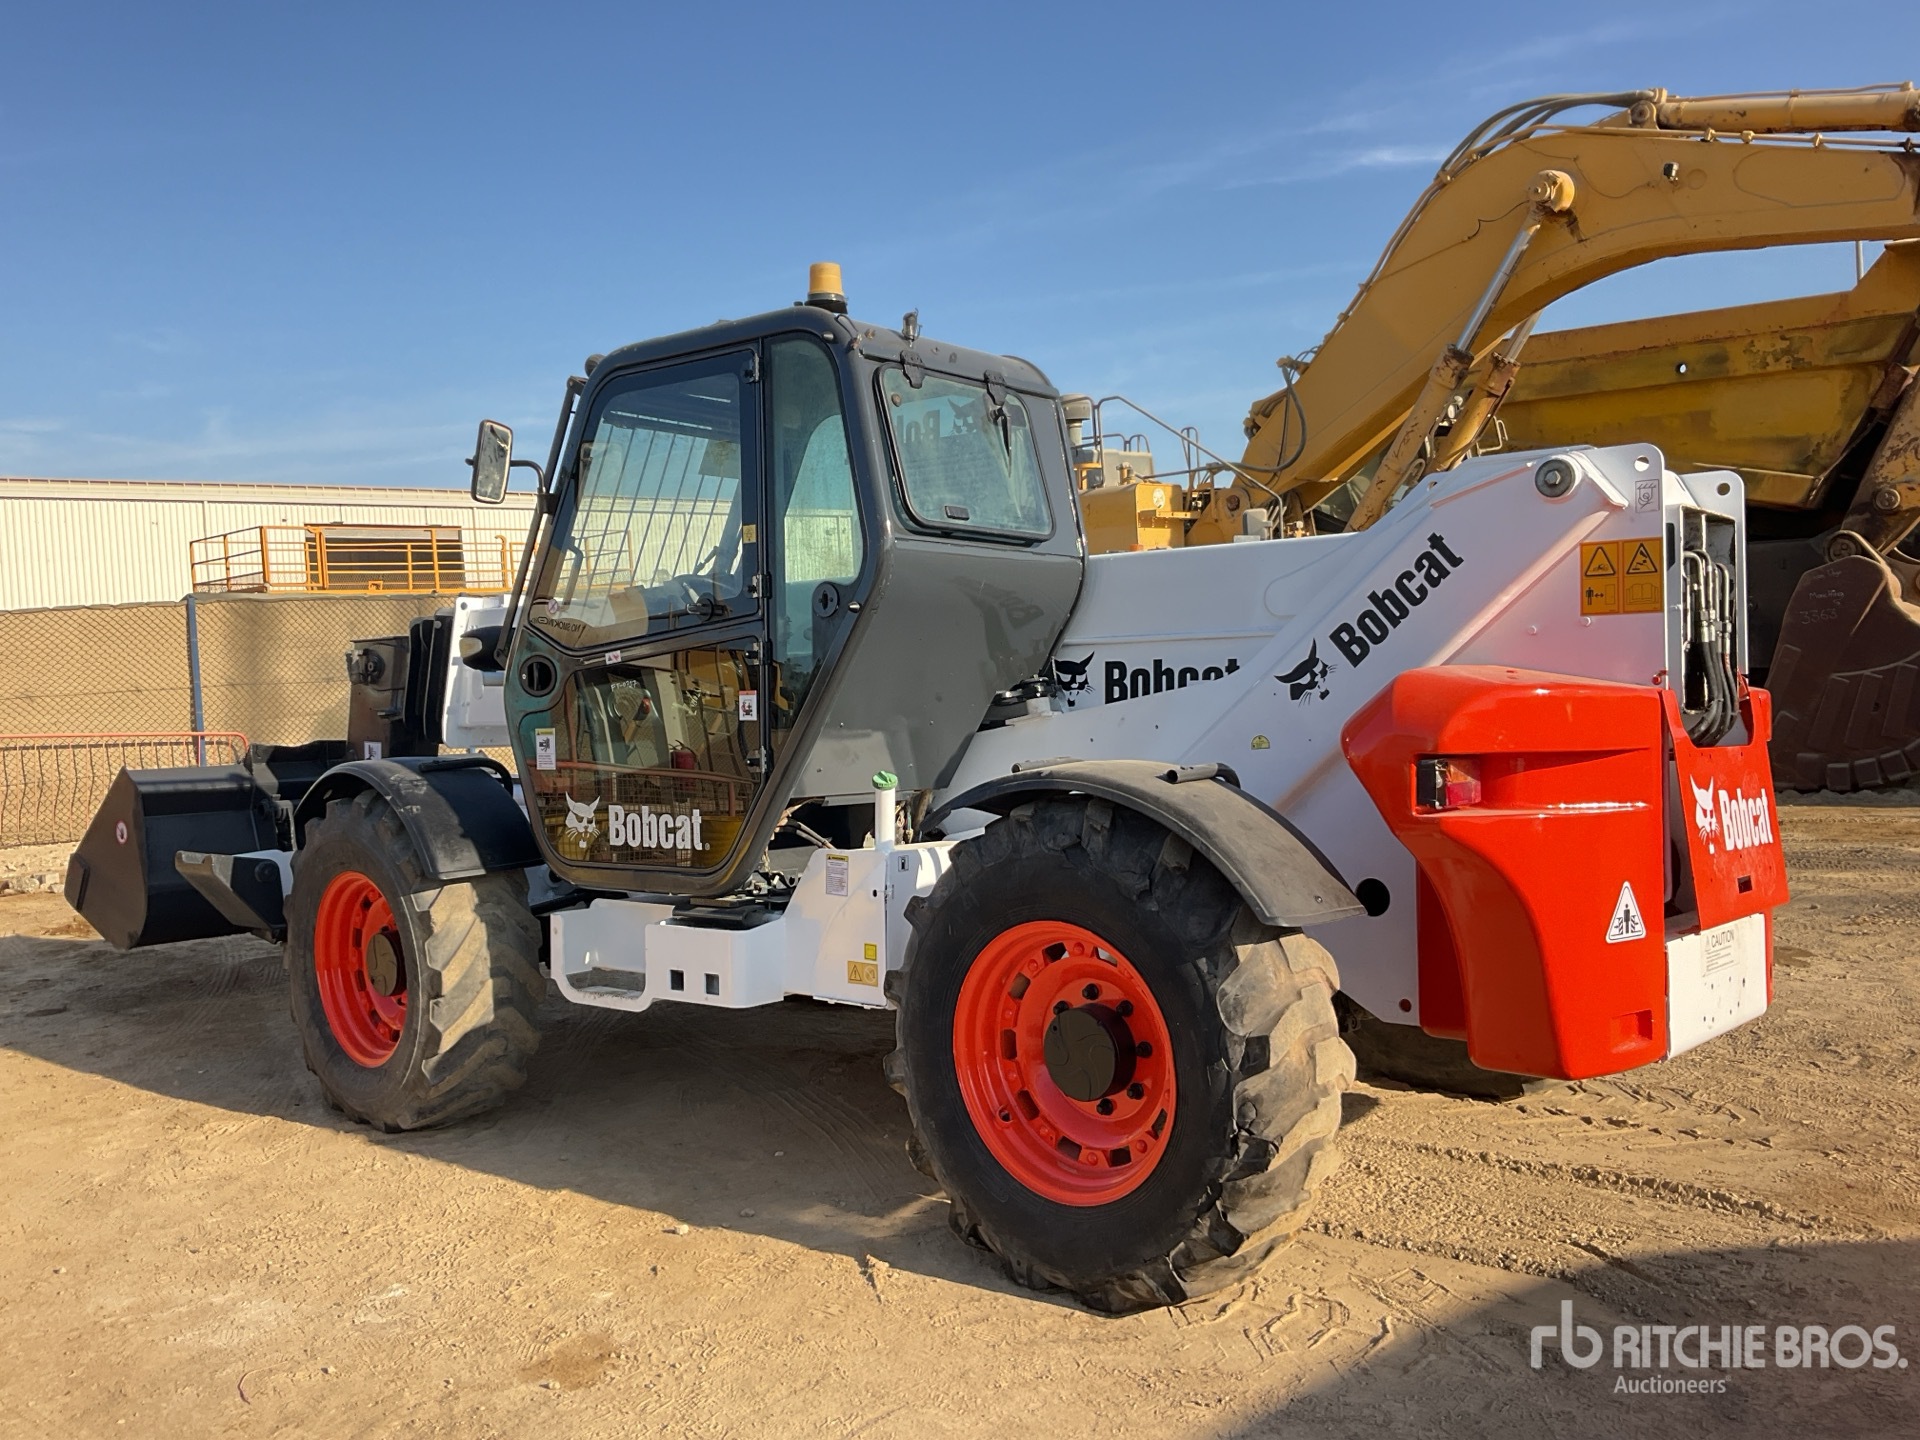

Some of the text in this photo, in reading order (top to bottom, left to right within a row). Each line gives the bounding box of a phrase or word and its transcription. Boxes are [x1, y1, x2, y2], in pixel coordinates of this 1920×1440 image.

[1328, 532, 1464, 668] Bobcat
[608, 804, 703, 850] Bobcat
[1718, 788, 1773, 851] Bobcat
[1710, 929, 1735, 948] CAUTION
